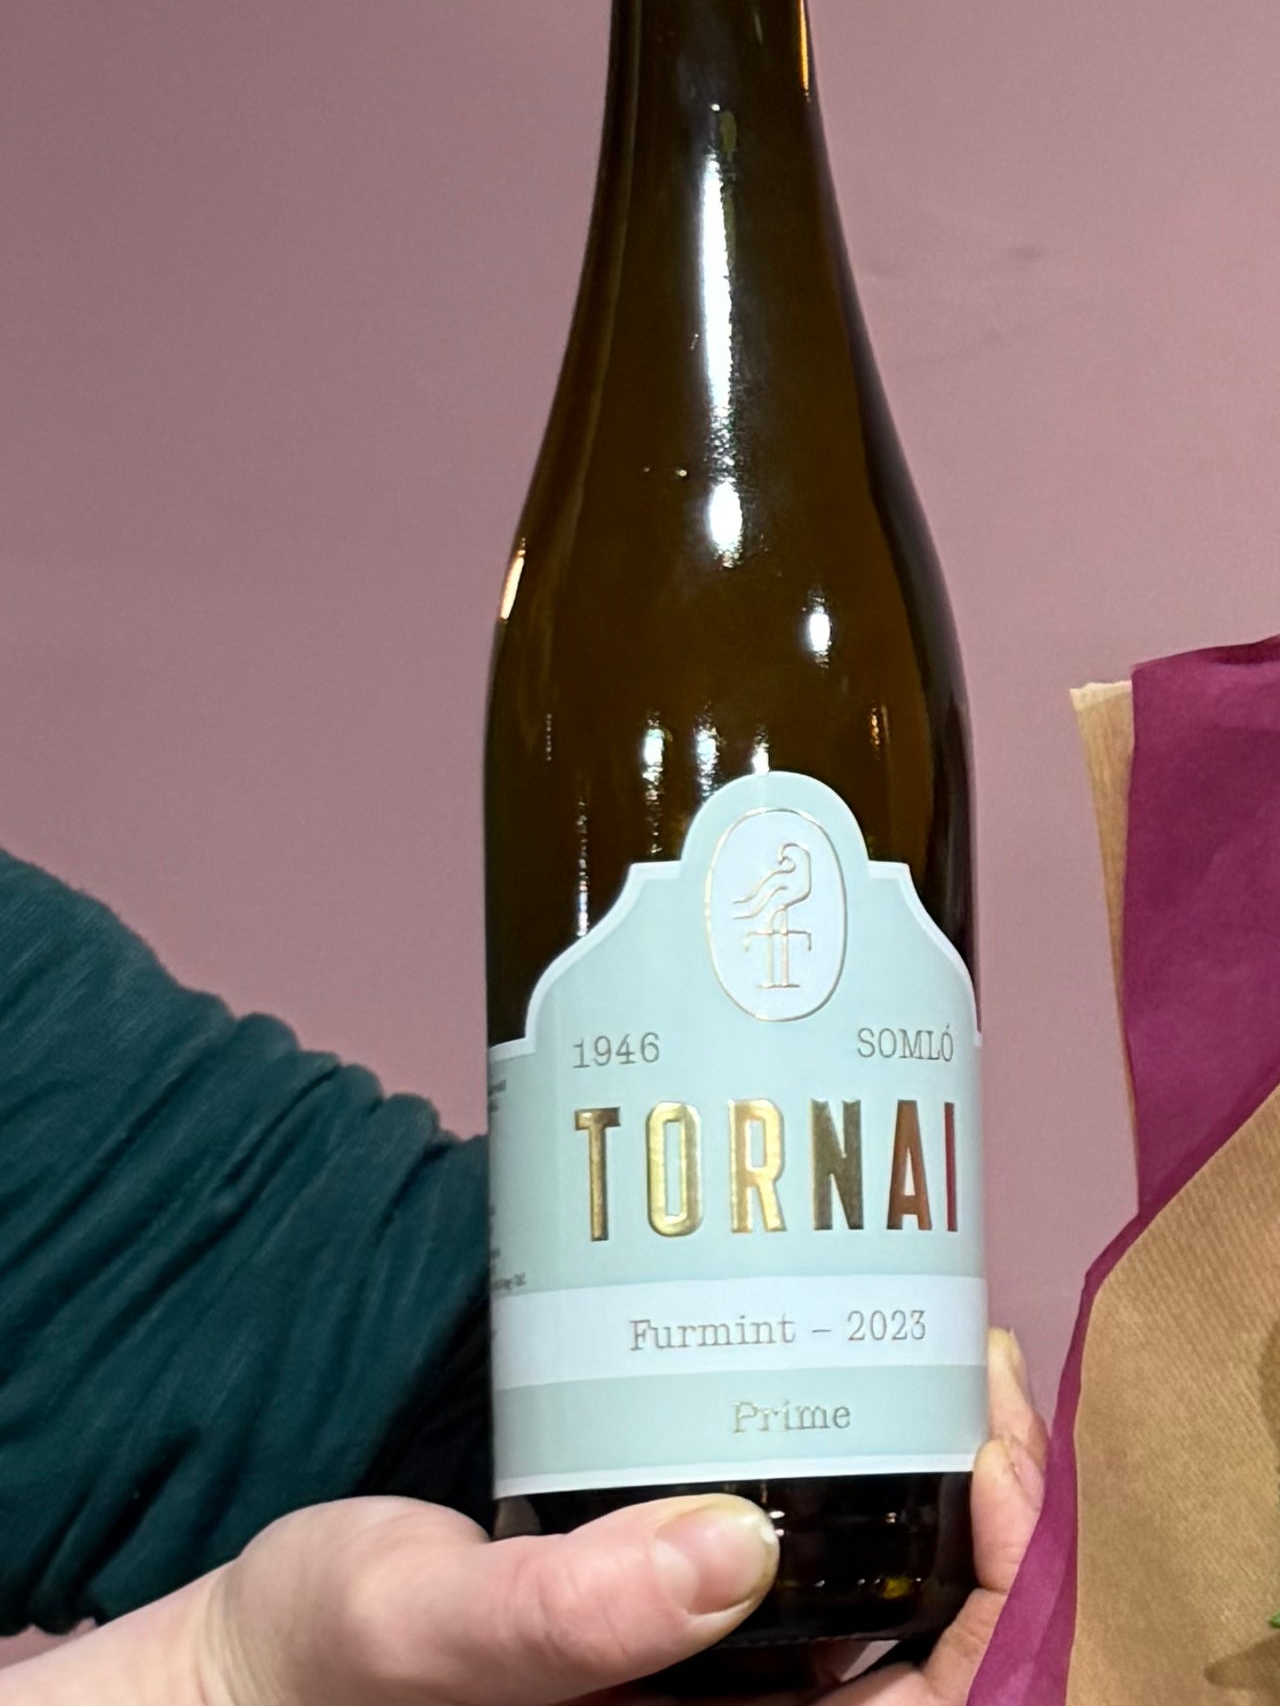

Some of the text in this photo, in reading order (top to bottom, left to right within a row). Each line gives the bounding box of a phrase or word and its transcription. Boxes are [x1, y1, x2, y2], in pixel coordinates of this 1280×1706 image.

[572, 1025, 954, 1068] 1946 SOMLÓ
[574, 1098, 958, 1241] TORNAI
[629, 1313, 796, 1351] Furmint
[846, 1309, 927, 1342] 2023
[732, 1399, 851, 1434] Prime
